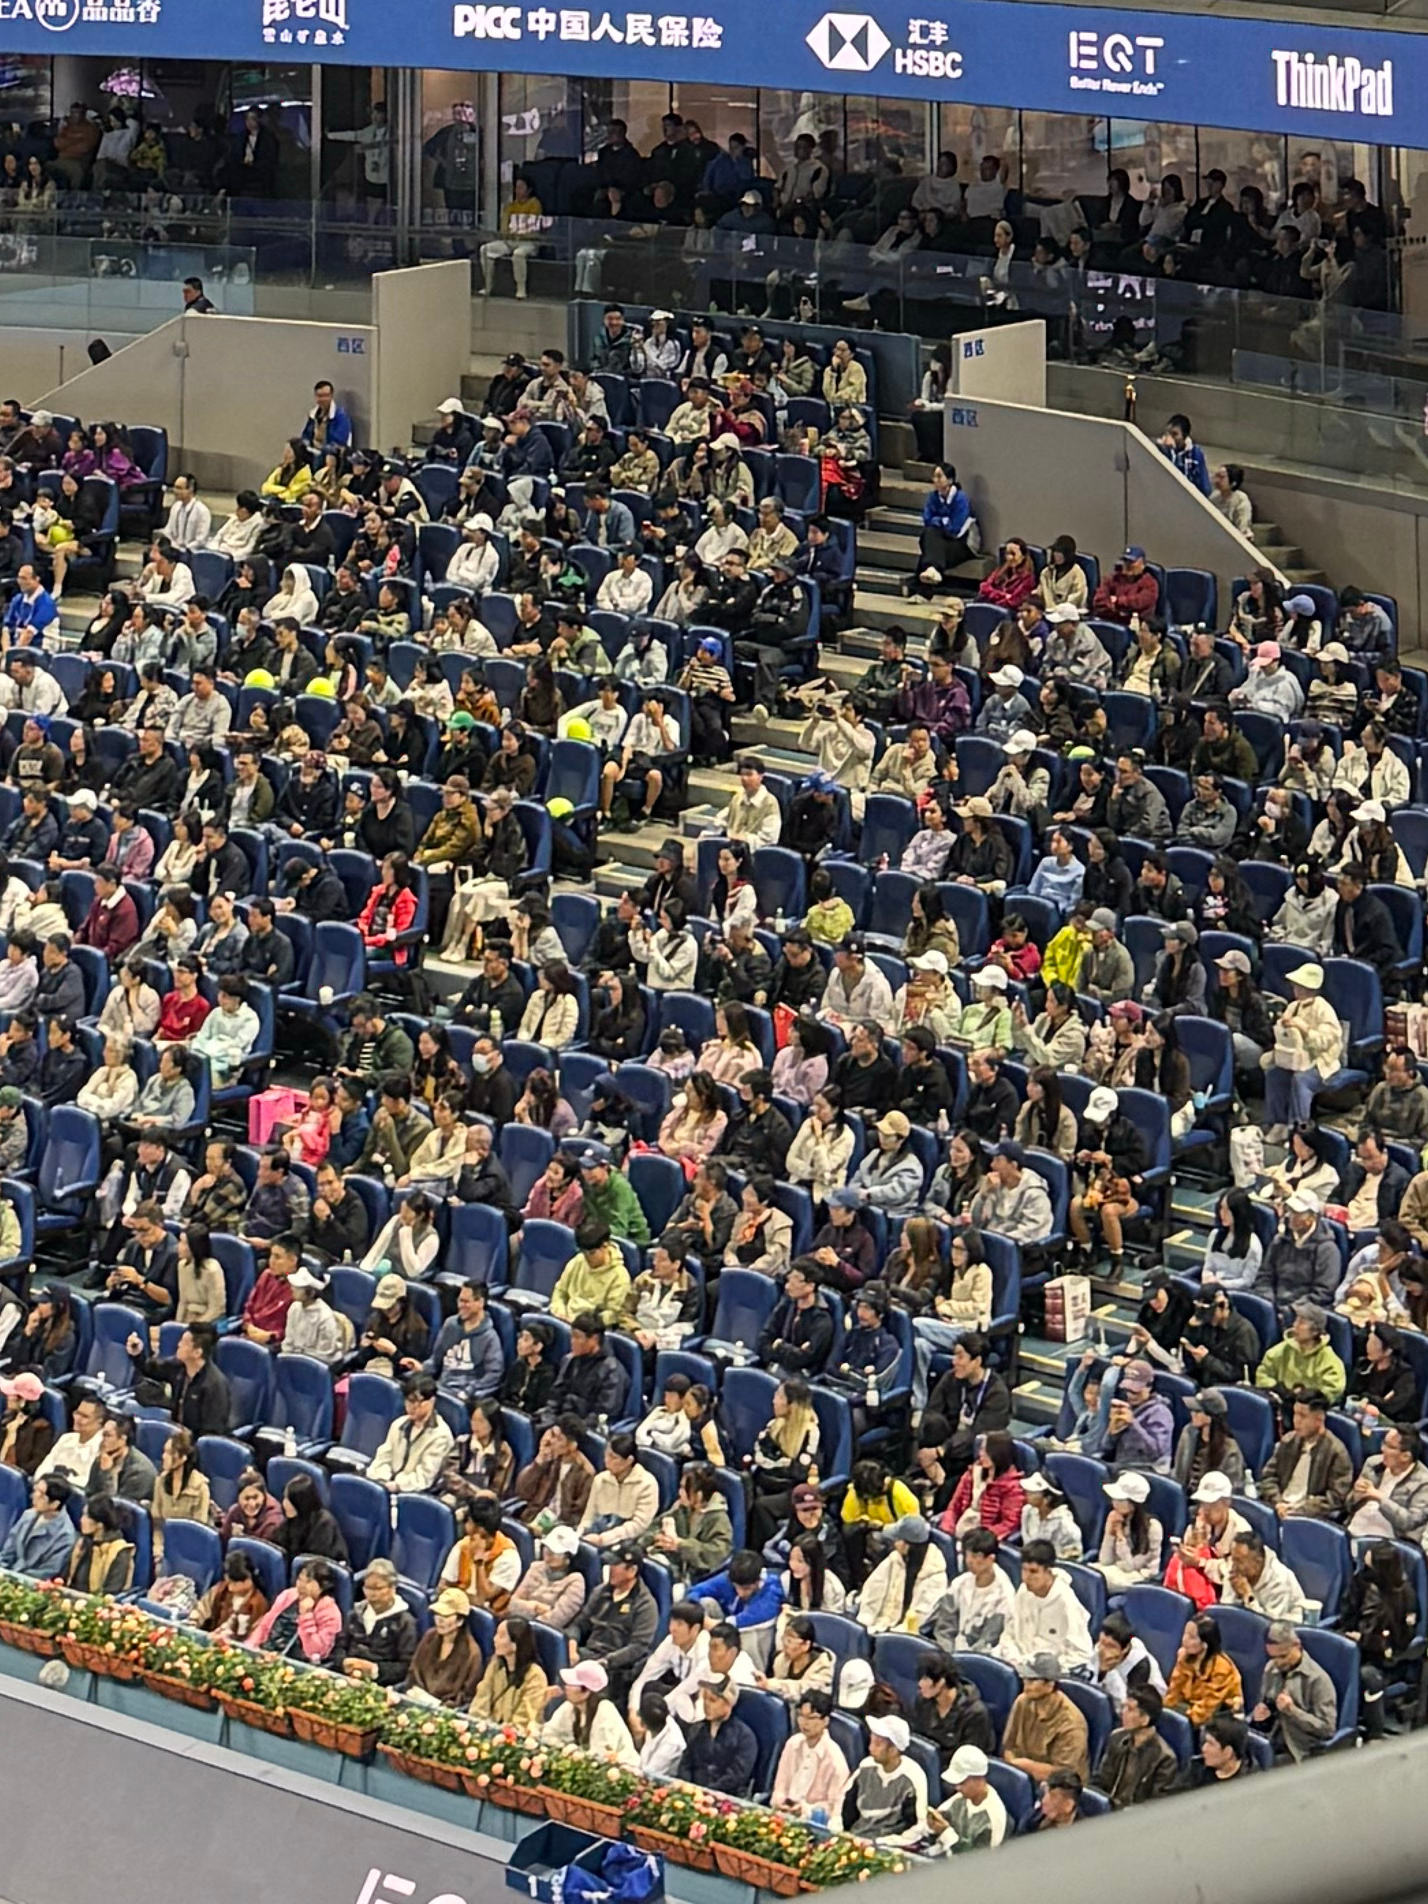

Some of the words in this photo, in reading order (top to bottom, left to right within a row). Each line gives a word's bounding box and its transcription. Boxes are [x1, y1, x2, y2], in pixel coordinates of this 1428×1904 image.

[453, 4, 522, 40] PICC
[527, 7, 724, 49] 中国人民保险
[908, 18, 949, 46] 汇丰
[894, 47, 964, 79] HSBC
[1069, 30, 1165, 75] EQT
[1271, 49, 1394, 116] ThinkPad
